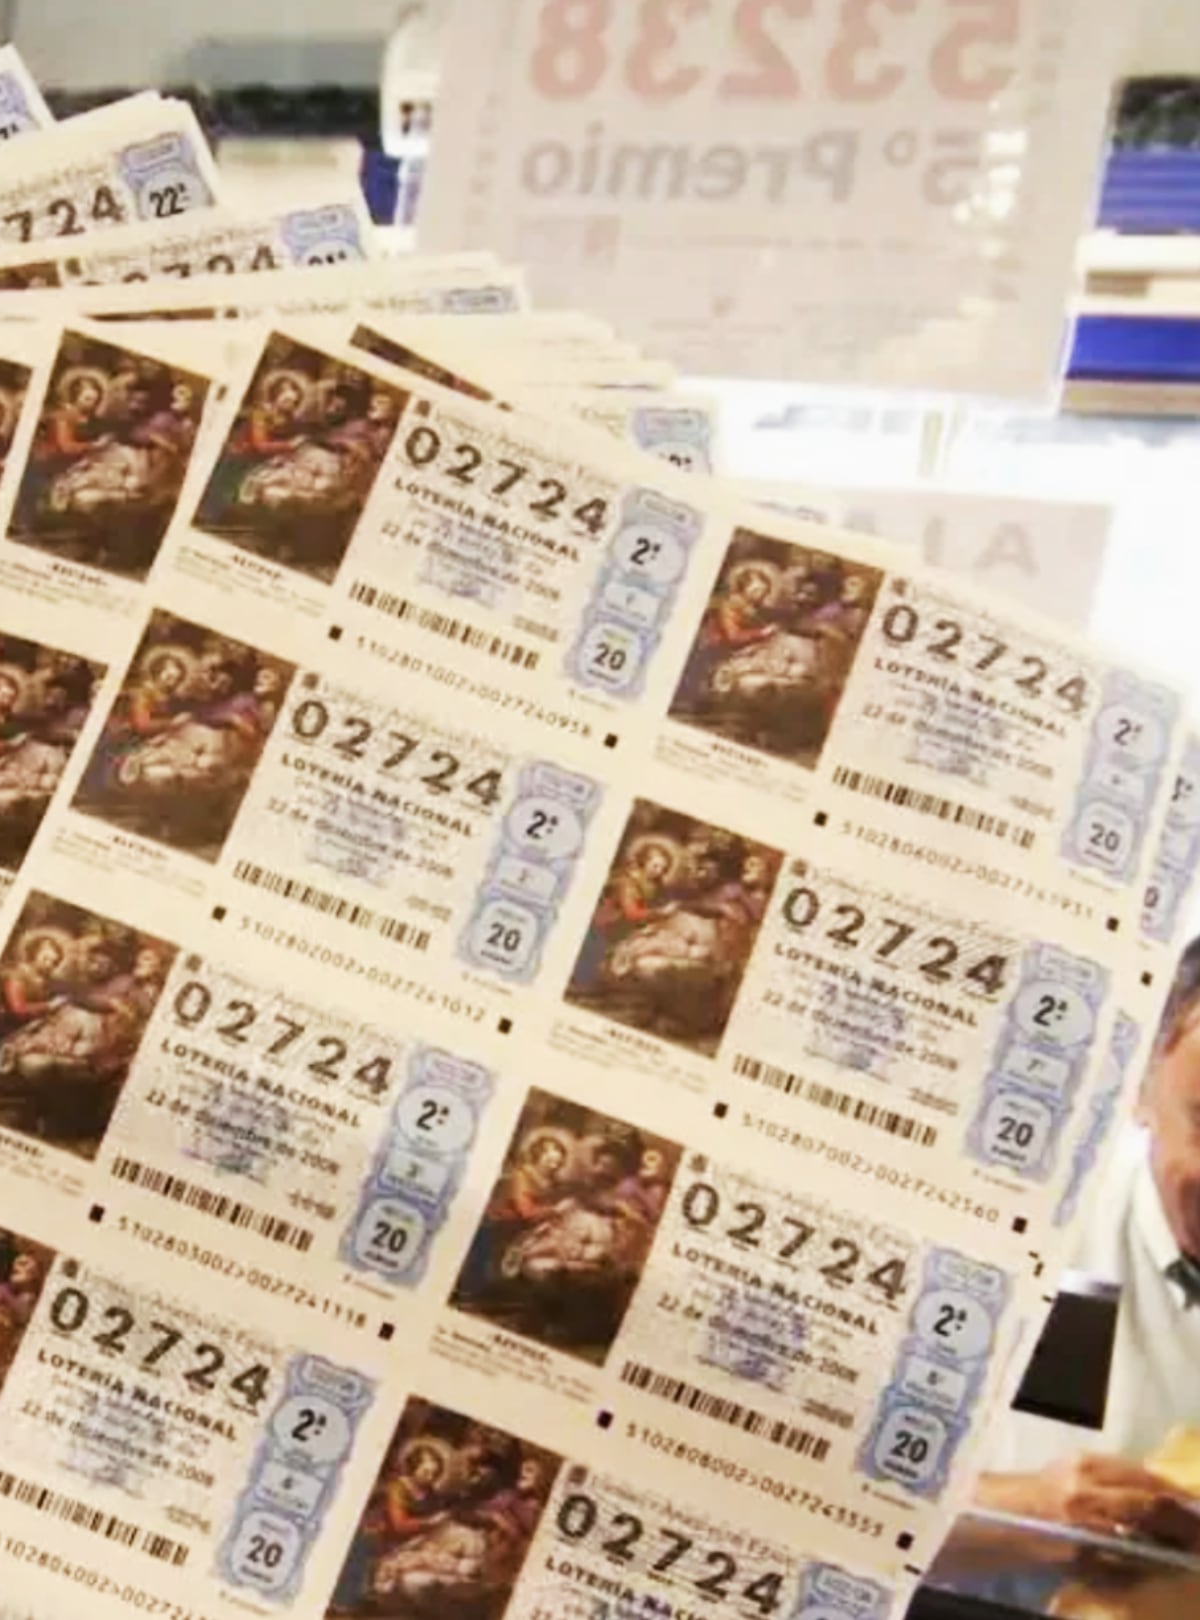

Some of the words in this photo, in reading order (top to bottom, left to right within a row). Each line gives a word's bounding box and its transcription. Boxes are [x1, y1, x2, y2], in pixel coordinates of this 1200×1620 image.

[404, 426, 608, 534] 02724
[593, 643, 626, 671] 20
[881, 604, 1089, 714] 02724
[291, 700, 502, 807] 02724
[1089, 822, 1120, 852] 20
[486, 921, 521, 952] 20
[781, 886, 1008, 996] 02724
[173, 980, 395, 1096] 02724
[996, 1116, 1034, 1149] 20
[371, 1219, 408, 1253] 20
[680, 1181, 909, 1303] 02724
[36, 1348, 125, 1394] LOTERÍA
[131, 1382, 238, 1442] NACIONAL
[49, 1286, 272, 1404] 02724
[889, 1429, 928, 1464] 20
[245, 1534, 283, 1567] 20
[555, 1494, 785, 1616] 02724
